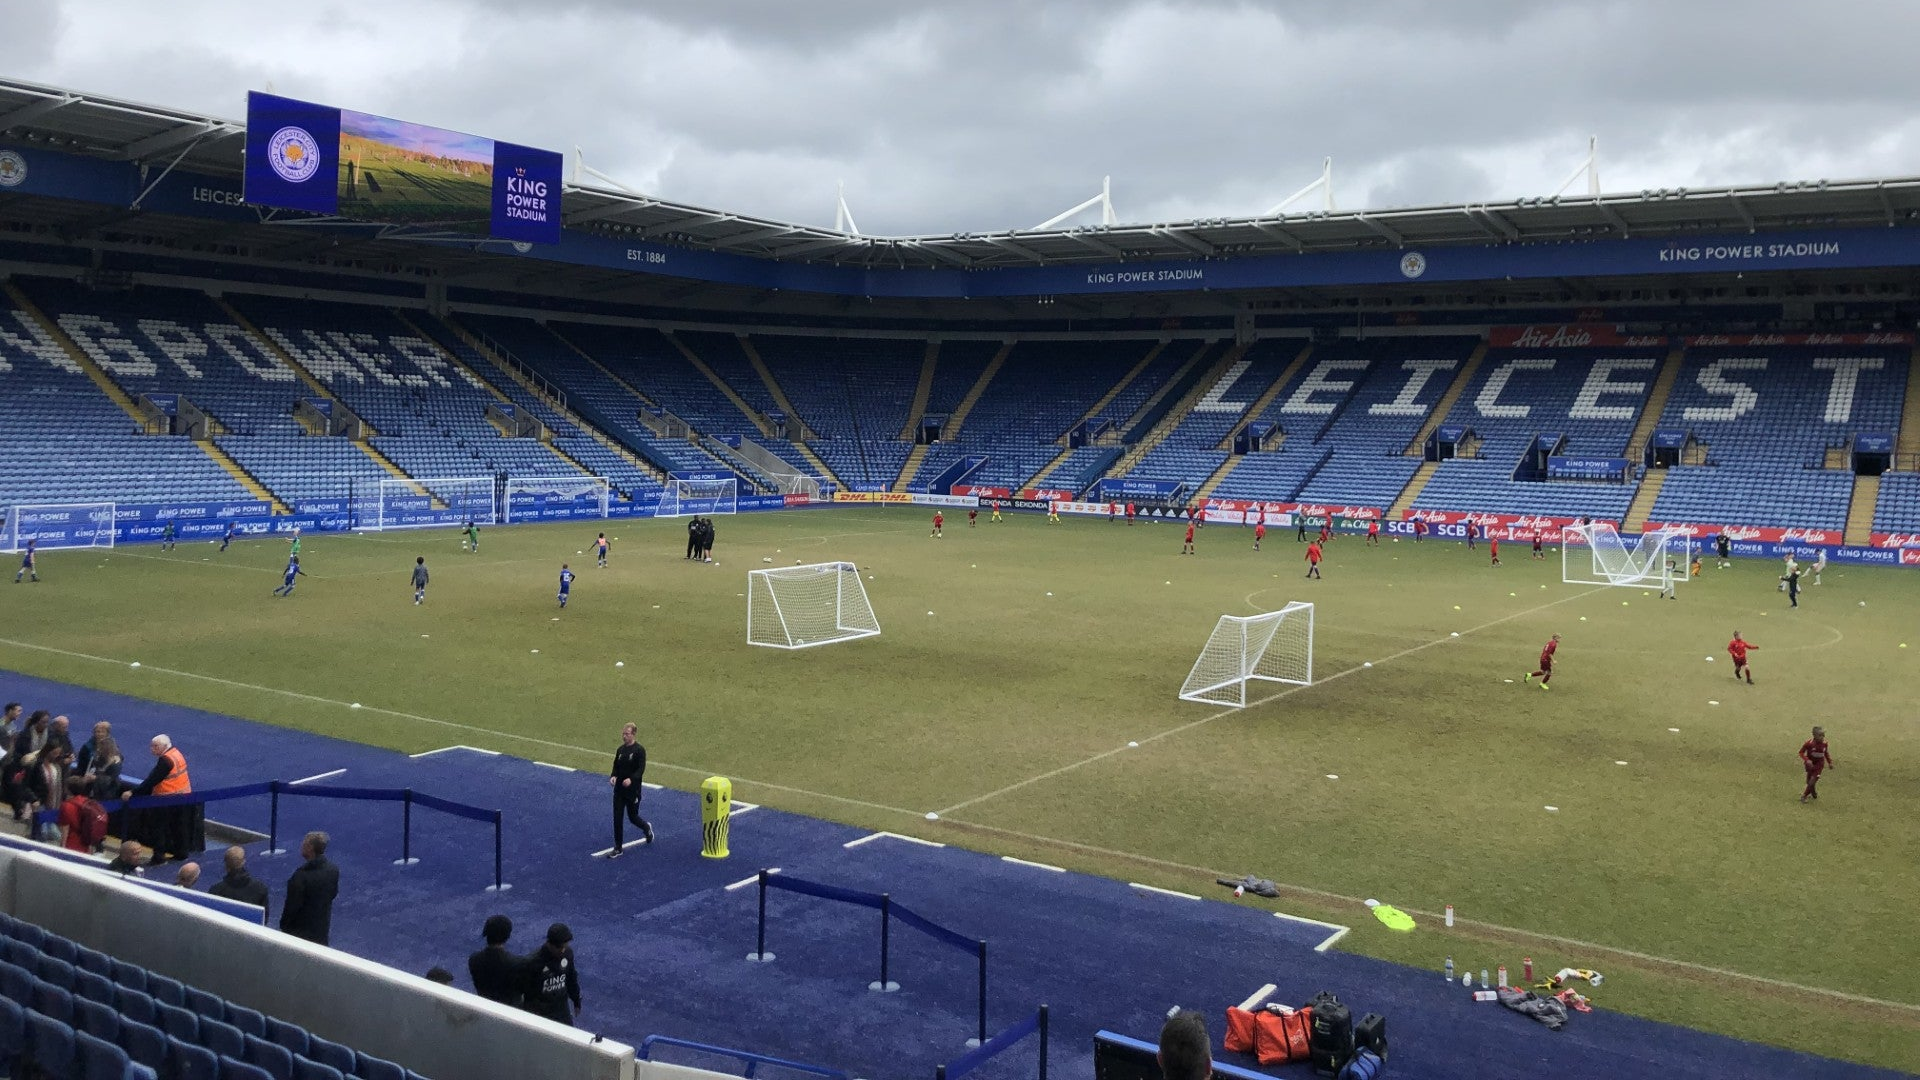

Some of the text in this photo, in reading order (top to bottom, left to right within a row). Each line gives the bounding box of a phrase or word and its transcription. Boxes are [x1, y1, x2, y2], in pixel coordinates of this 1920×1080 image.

[507, 176, 548, 197] KING
[193, 187, 243, 206] LEICES
[507, 193, 547, 211] POWER
[506, 206, 547, 222] STADIUM
[627, 249, 666, 264] EST. 1884
[1659, 242, 1840, 261] KING POWER STADIUM
[1087, 269, 1203, 283] KING POWER STADIUM
[980, 499, 1012, 507] SEKNDA
[1388, 521, 1415, 533] SCB
[1437, 524, 1466, 537] SCB
[1733, 544, 1763, 552] POWER
[1837, 549, 1894, 559] KING POWER
[543, 974, 567, 986] KING
[543, 981, 566, 993] POWER
